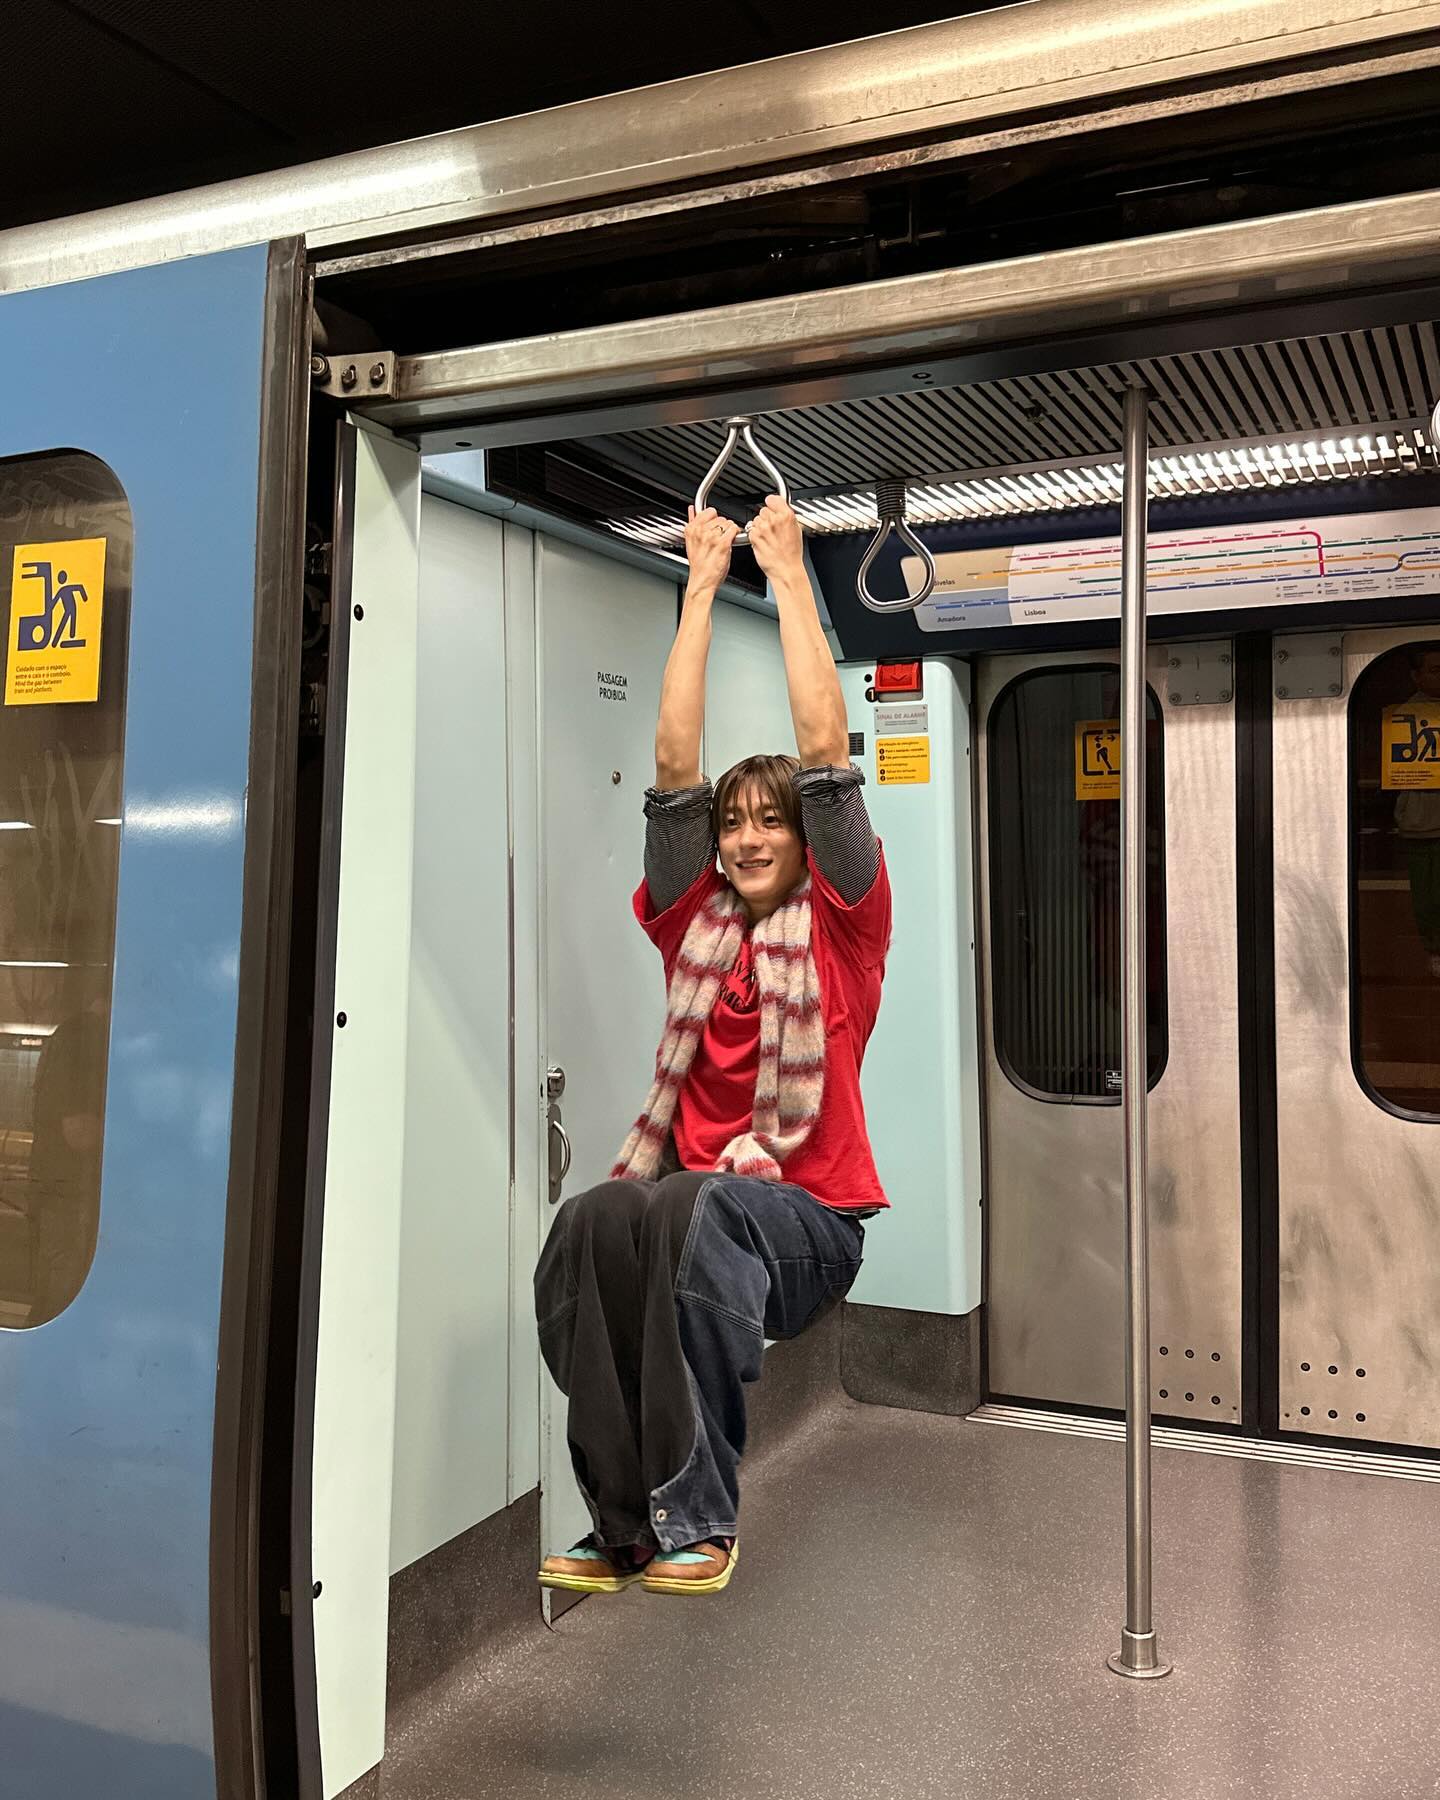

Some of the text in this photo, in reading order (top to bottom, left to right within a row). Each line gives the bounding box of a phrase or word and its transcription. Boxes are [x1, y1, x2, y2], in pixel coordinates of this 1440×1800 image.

[1024, 609, 1047, 617] Lisboa
[937, 615, 966, 624] Amadora
[598, 671, 627, 687] PASSAGEM
[599, 687, 626, 702] PROIBIDA
[903, 711, 926, 719] ALARME
